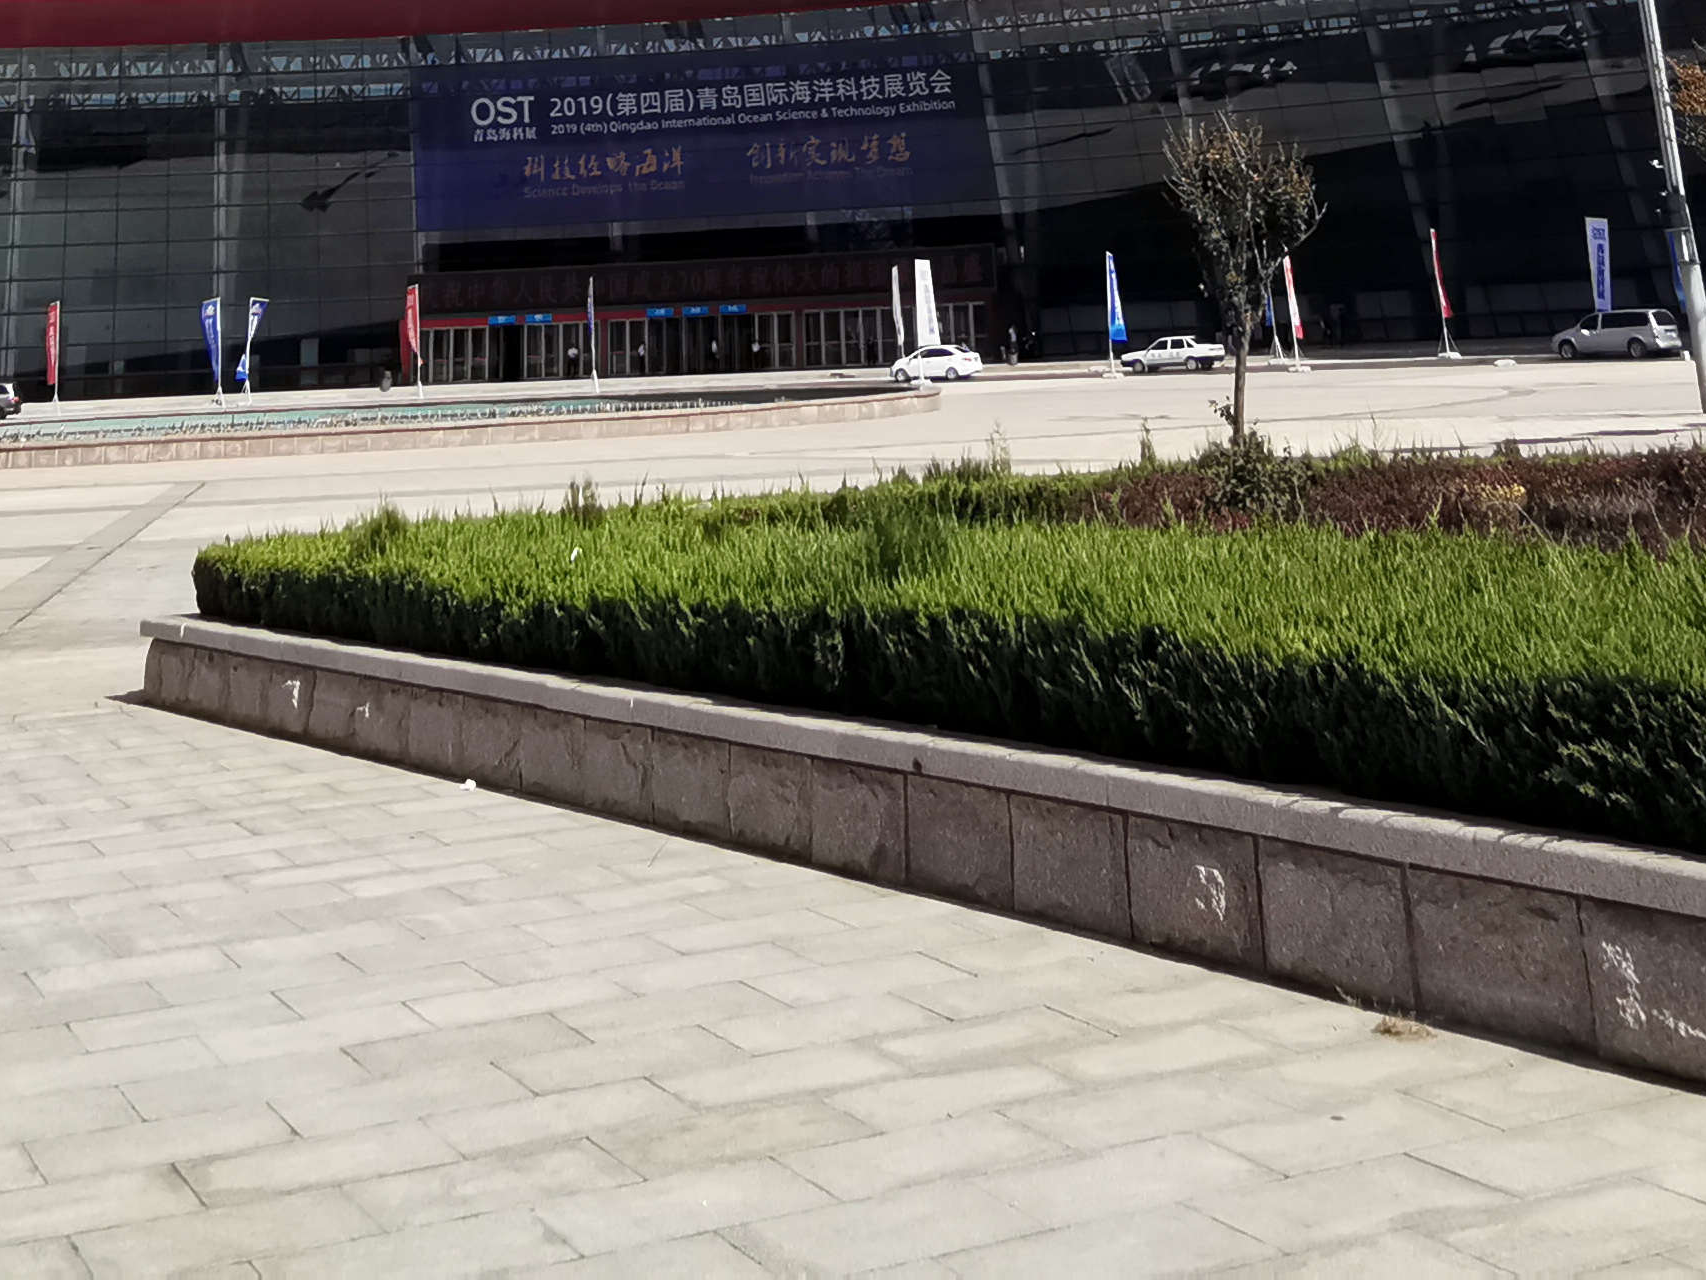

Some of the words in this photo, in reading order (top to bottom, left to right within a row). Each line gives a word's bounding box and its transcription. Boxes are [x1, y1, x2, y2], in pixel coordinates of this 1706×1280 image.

[470, 95, 536, 127] OST
[551, 124, 578, 136] 2019
[580, 122, 608, 135] (4th)
[610, 119, 659, 134] Qingdao
[662, 113, 735, 130] International
[738, 111, 773, 125] Ocean
[776, 107, 818, 122] Science
[831, 101, 897, 119] Technology
[899, 98, 956, 114] Exhibition
